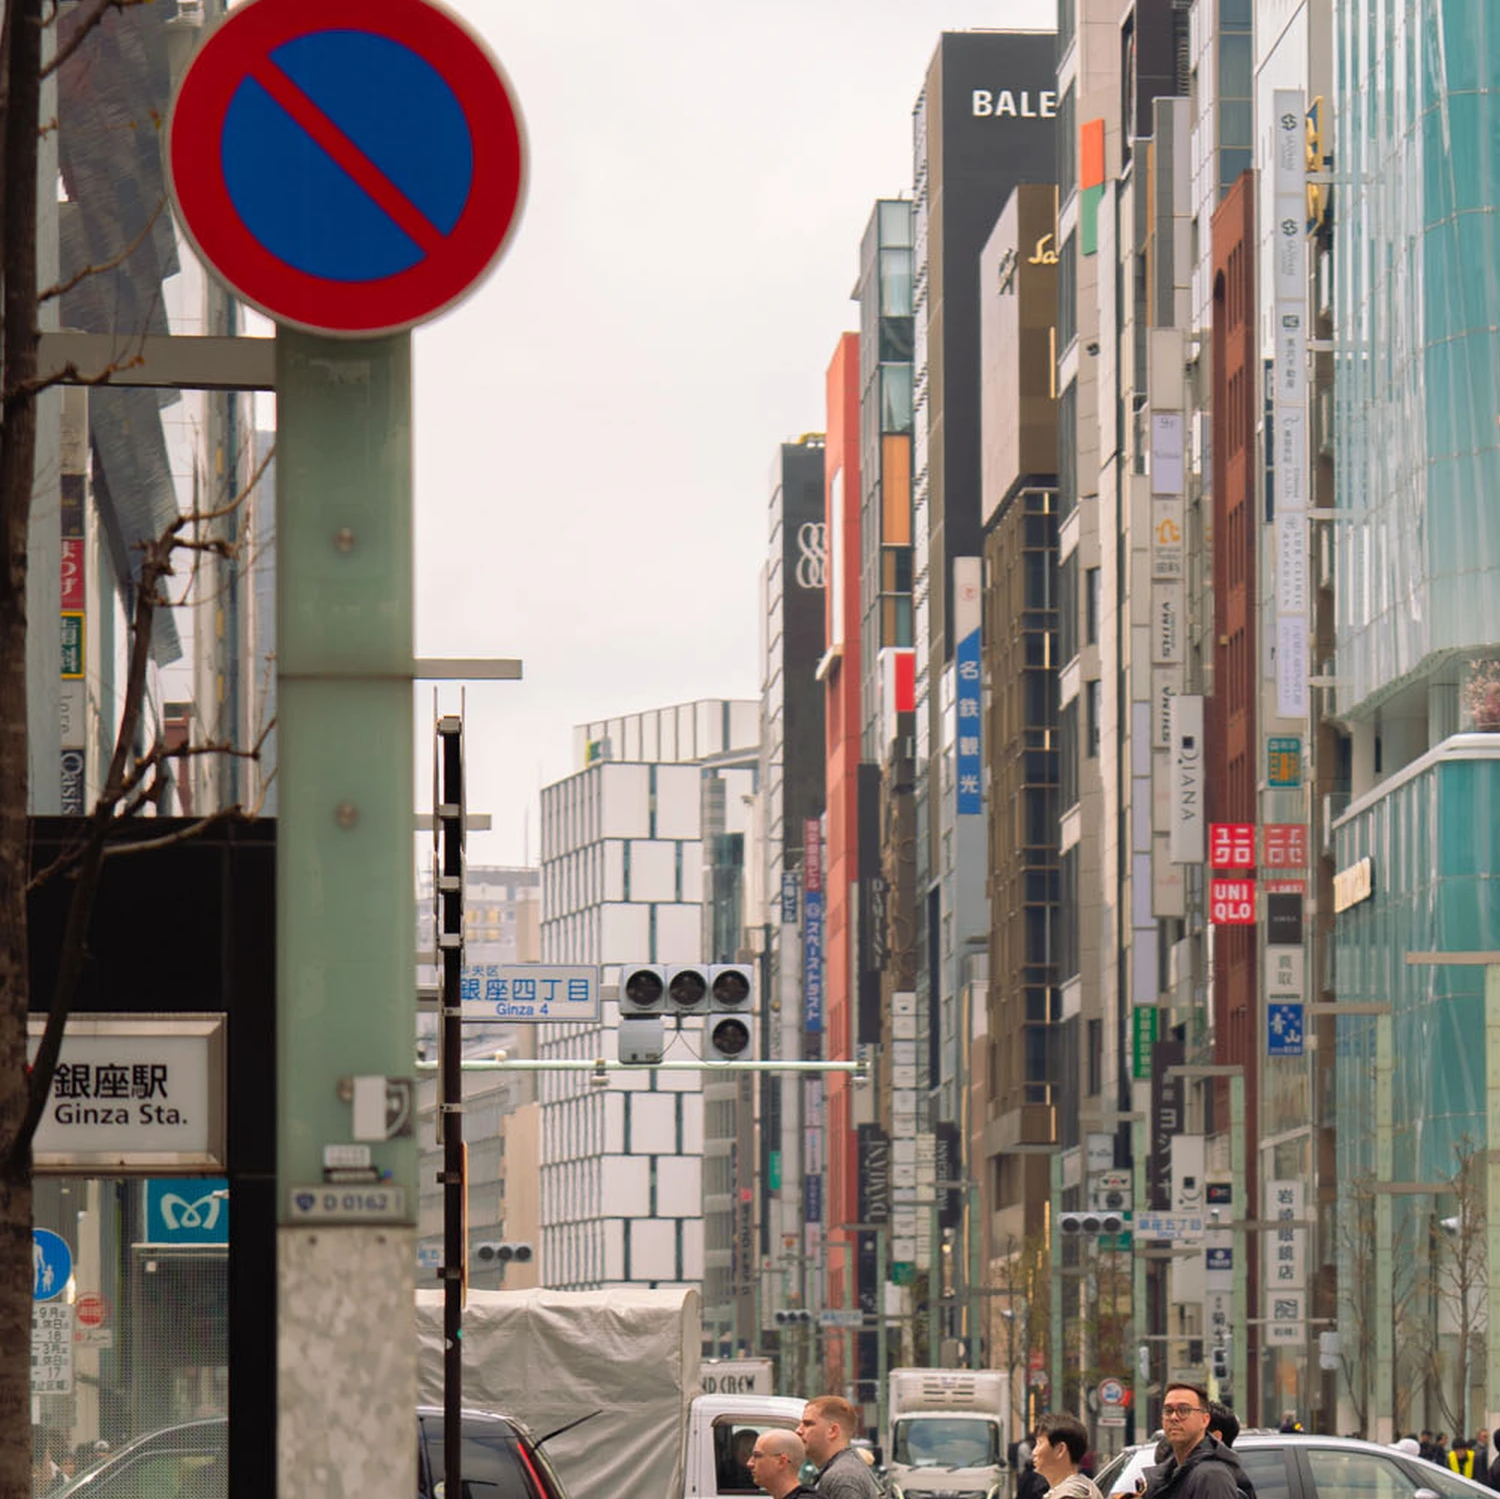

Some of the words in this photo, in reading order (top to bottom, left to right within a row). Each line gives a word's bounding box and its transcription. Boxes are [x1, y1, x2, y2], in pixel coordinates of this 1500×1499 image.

[1212, 828, 1248, 844] ユニ
[1212, 847, 1248, 864] クロ
[1212, 884, 1246, 901] UNI
[1212, 903, 1248, 920] QLO
[461, 978, 589, 1002] 銀座四丁目
[496, 1002, 534, 1016] Ginza
[540, 1003, 550, 1015] 4
[54, 1063, 168, 1100] 銀座駅
[54, 1103, 129, 1125] Ginza
[139, 1103, 188, 1125] Sta.
[343, 1193, 387, 1212] 0162
[719, 1375, 755, 1394] CREW
